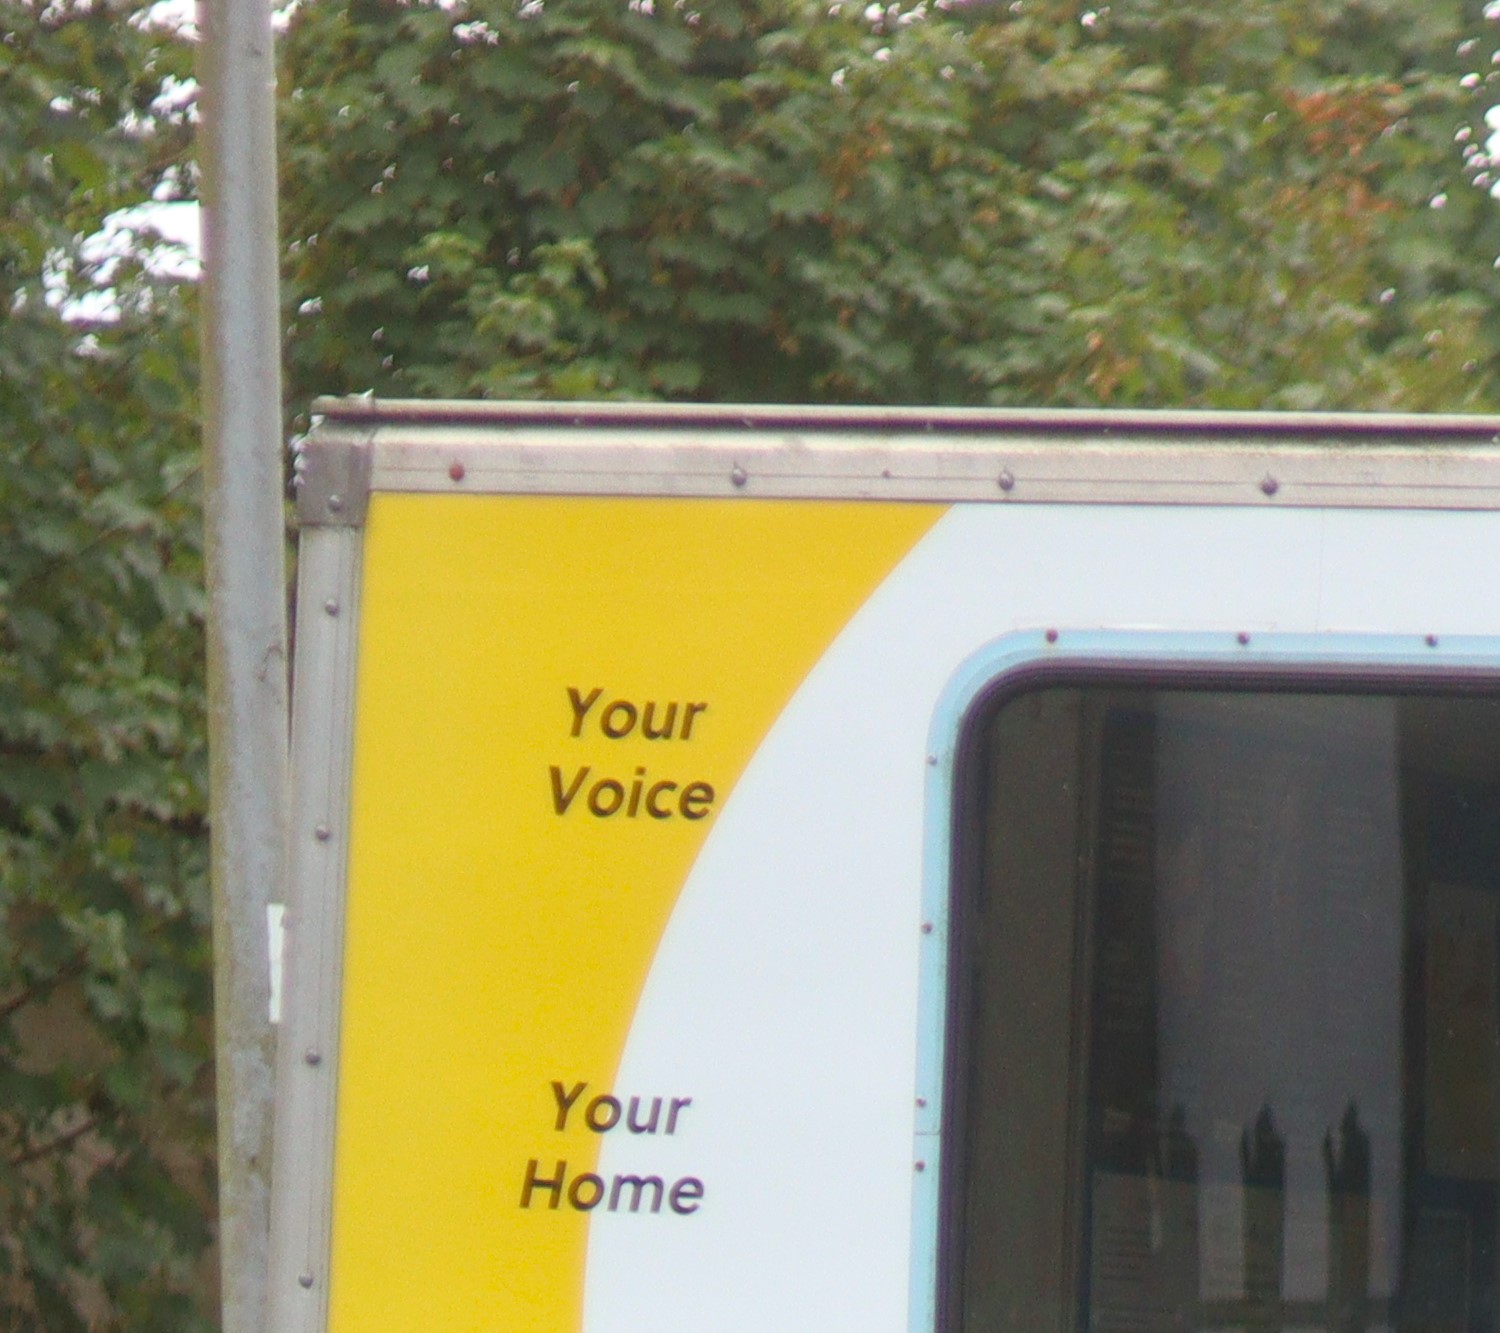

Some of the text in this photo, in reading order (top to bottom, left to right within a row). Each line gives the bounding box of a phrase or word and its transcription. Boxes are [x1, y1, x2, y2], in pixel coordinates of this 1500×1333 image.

[566, 687, 708, 741] Your
[548, 765, 716, 822] Voice
[551, 1081, 692, 1135] Your
[519, 1159, 705, 1216] Home
